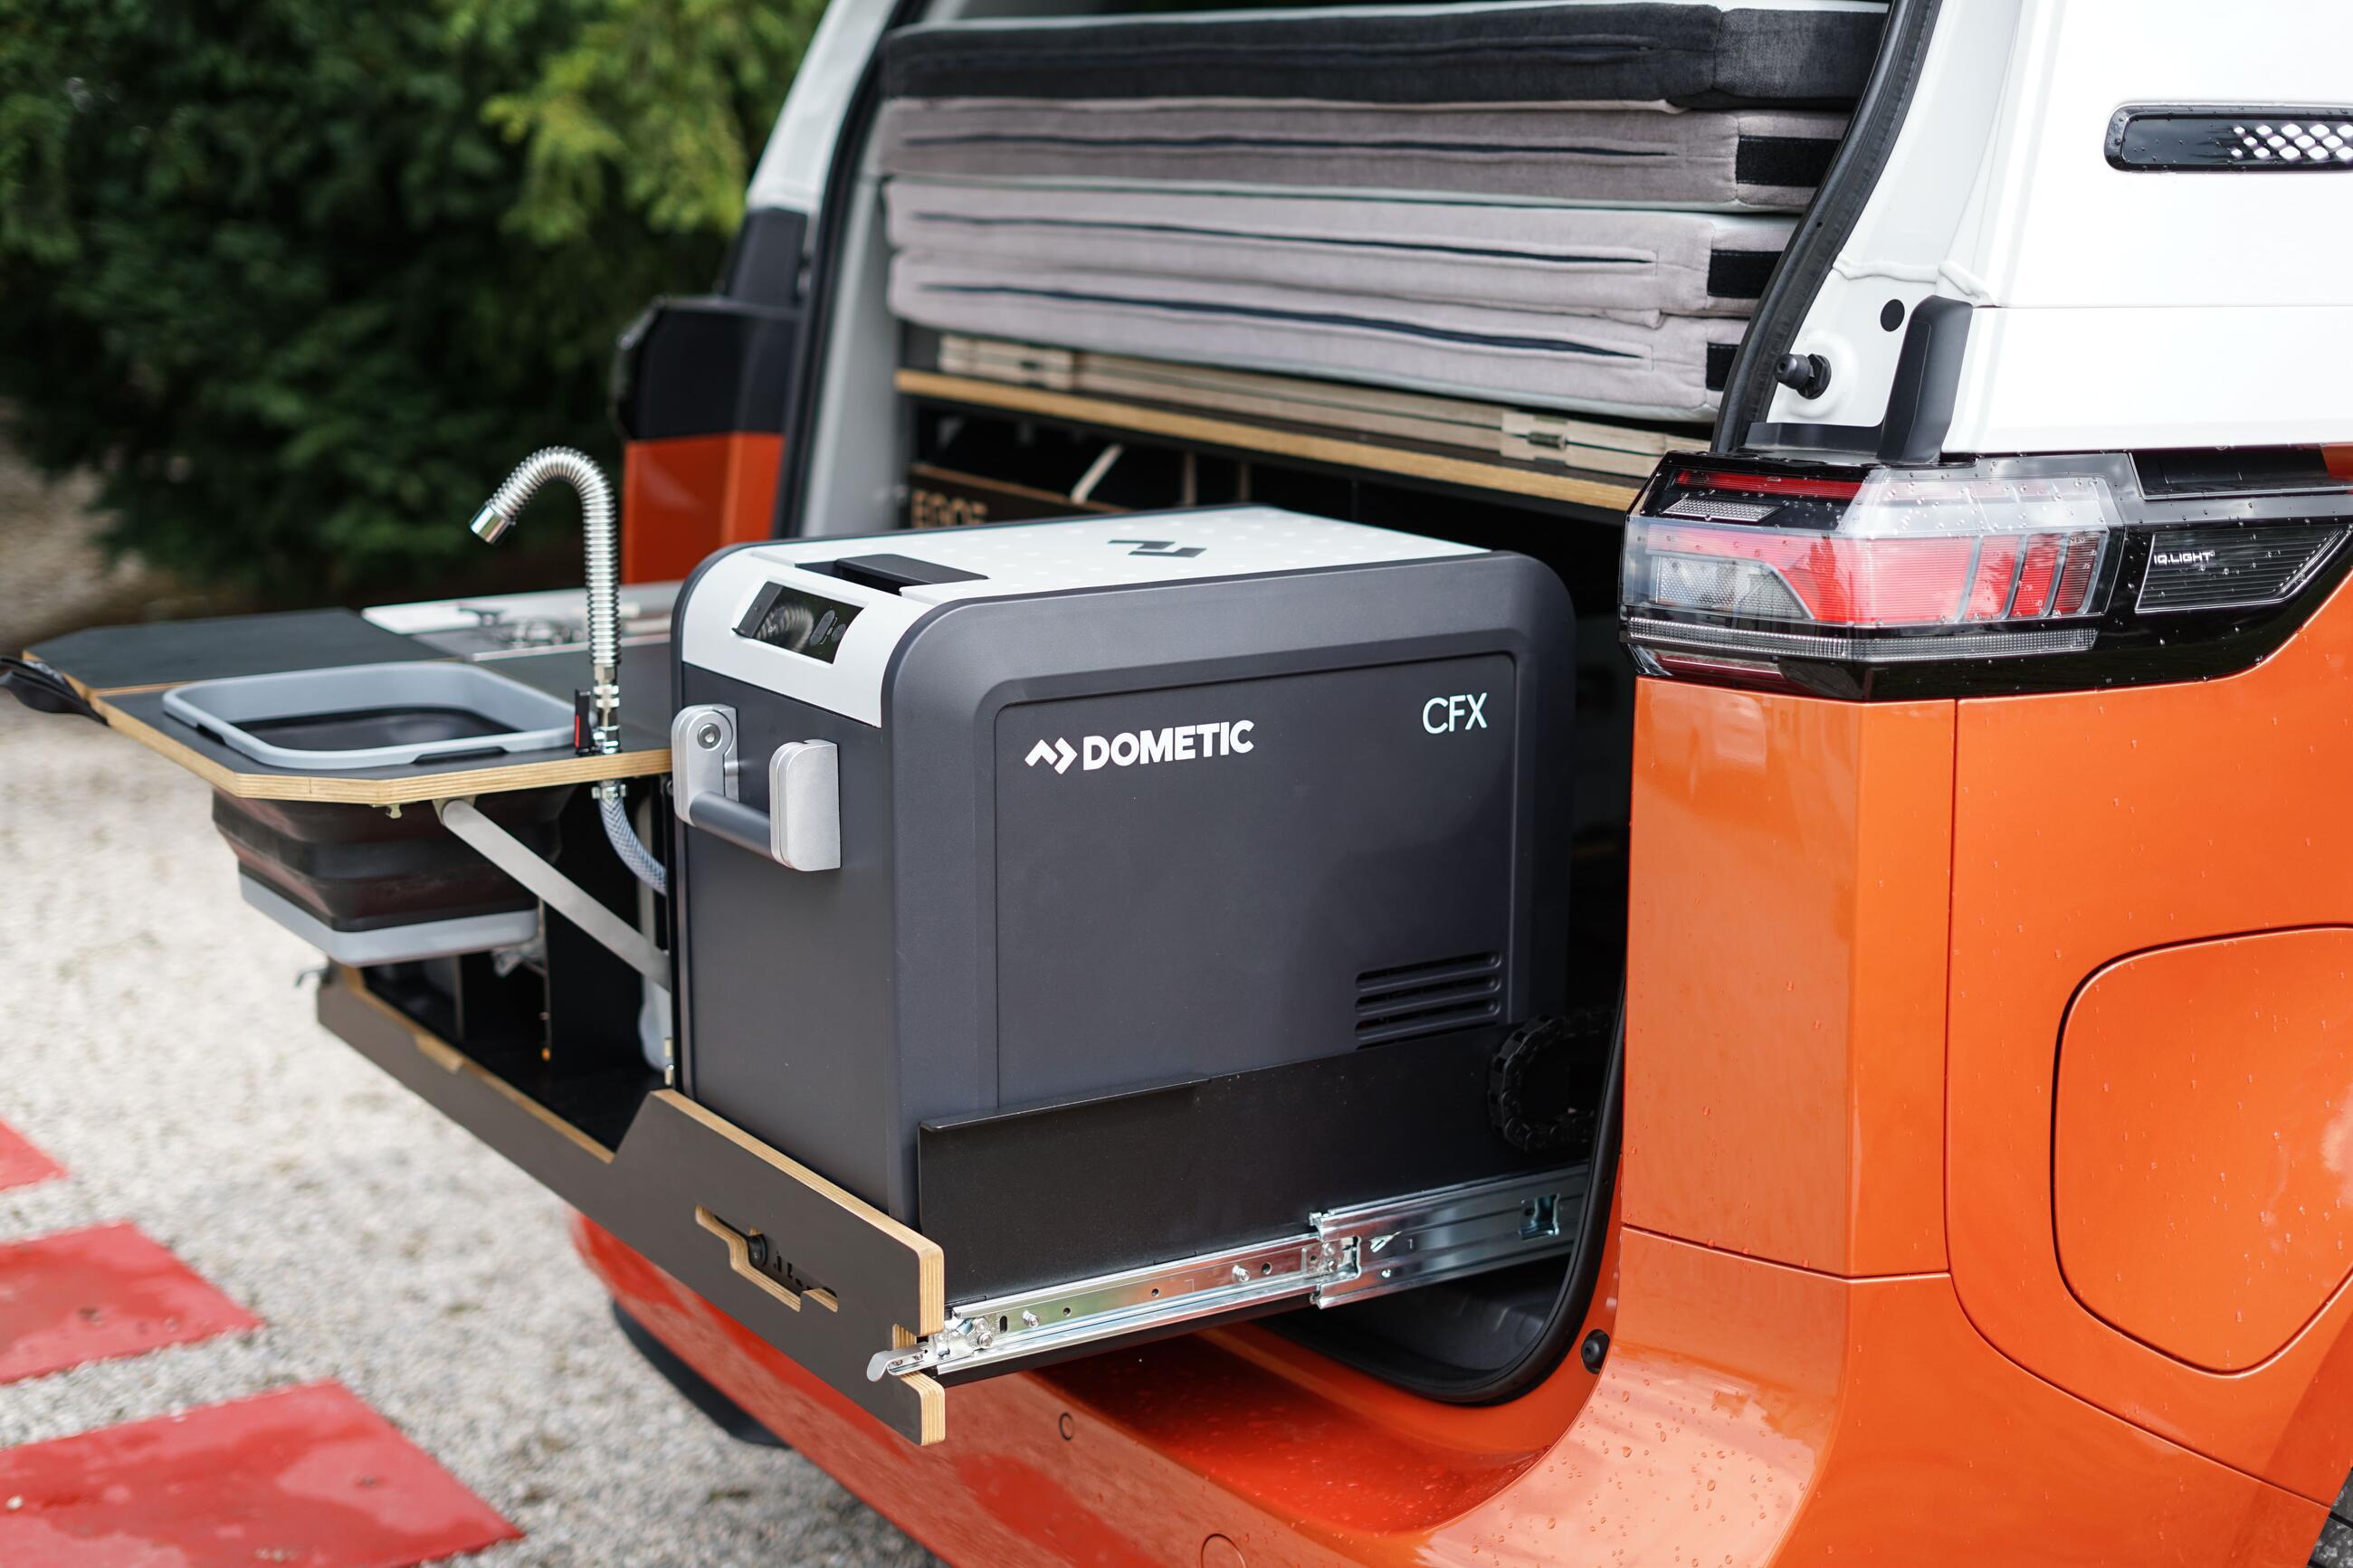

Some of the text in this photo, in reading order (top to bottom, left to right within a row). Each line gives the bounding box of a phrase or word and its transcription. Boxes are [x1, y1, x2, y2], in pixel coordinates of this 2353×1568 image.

[2154, 552, 2211, 565] IQ.LIGHT
[1422, 692, 1488, 735] CFX
[1083, 719, 1254, 771] DOMETIC
